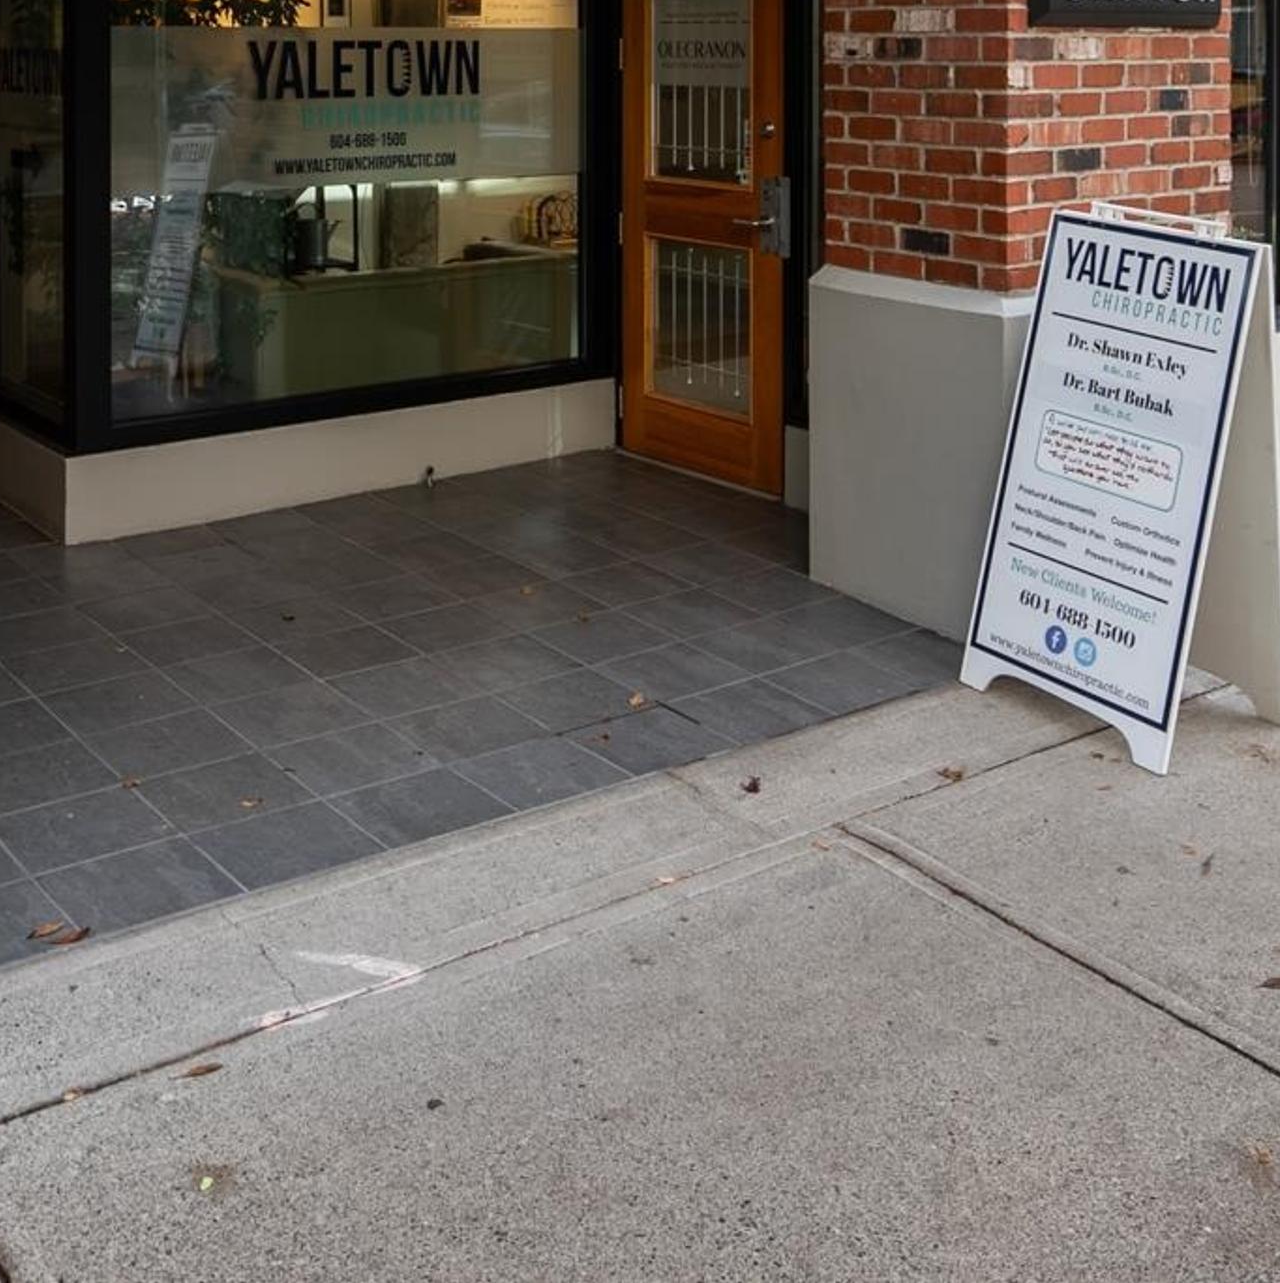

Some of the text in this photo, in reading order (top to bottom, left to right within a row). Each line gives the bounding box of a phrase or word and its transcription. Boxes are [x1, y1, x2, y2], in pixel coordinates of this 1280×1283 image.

[246, 38, 481, 100] YALETOWN
[273, 150, 457, 175] WWW.YALETOWNCHIROPRACTIC.COM
[1065, 237, 1232, 313] YALETOWN
[1091, 290, 1224, 336] CHIROPRACTIC
[1066, 331, 1189, 381] Dr. Shawn Exley
[1062, 370, 1176, 417] Dr. Bart Bubak
[1009, 521, 1034, 537] Family
[1109, 515, 1142, 534] Custom
[1112, 536, 1148, 558] Optimize
[1083, 547, 1114, 565] Prevent
[1010, 556, 1157, 626] New Clients Welcome!
